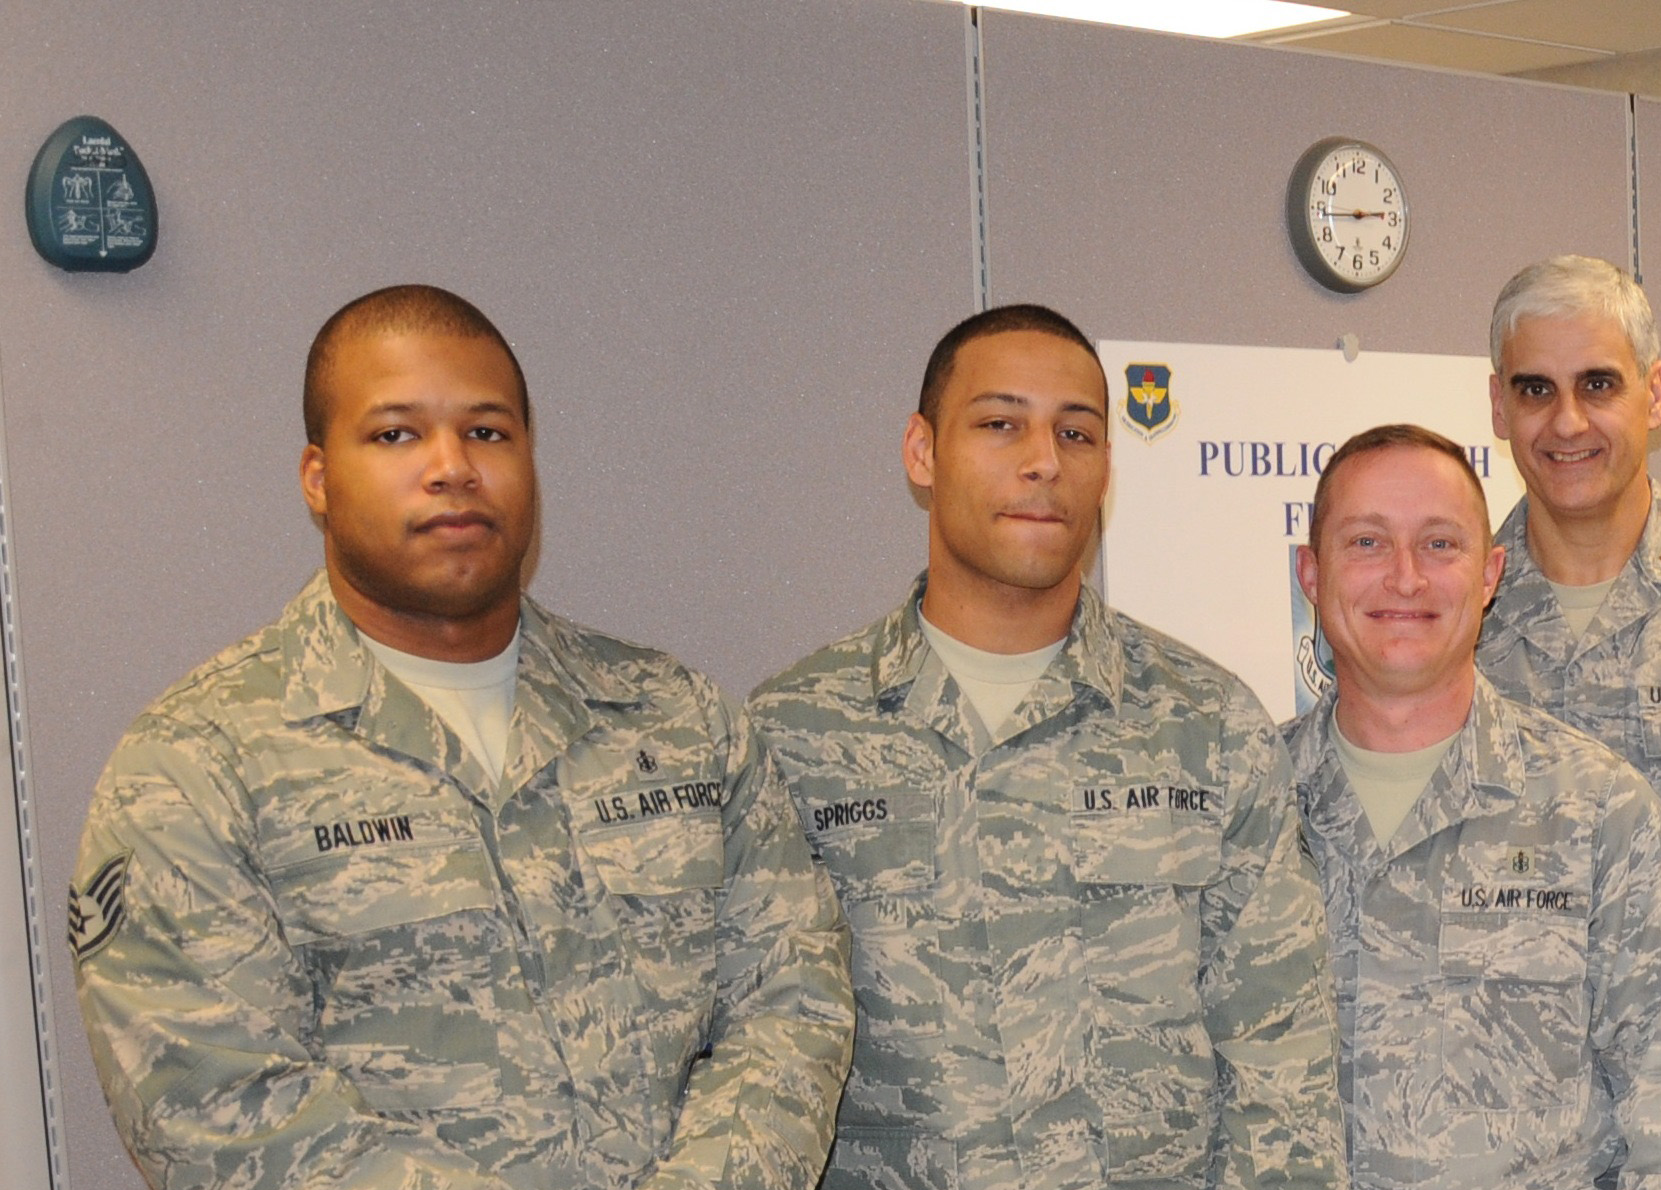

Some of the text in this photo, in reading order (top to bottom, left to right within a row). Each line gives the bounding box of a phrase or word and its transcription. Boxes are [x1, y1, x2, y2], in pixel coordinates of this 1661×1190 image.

[1352, 159, 1366, 174] 12
[1321, 180, 1337, 195] 10
[1383, 188, 1393, 204] 2
[1388, 212, 1397, 227] 3
[1322, 227, 1333, 242] 8
[1382, 236, 1391, 249] 4
[1336, 246, 1346, 260] 7
[1369, 250, 1379, 265] 5
[1353, 254, 1363, 270] 6
[594, 799, 635, 823] U.S.
[639, 787, 673, 818] AIR
[1126, 785, 1161, 810] AIR
[1168, 786, 1210, 812] FORCE
[814, 798, 888, 832] SPRIGGS
[314, 815, 415, 852] BALDWIN
[1461, 887, 1573, 912] U.S. AIR FORCE
